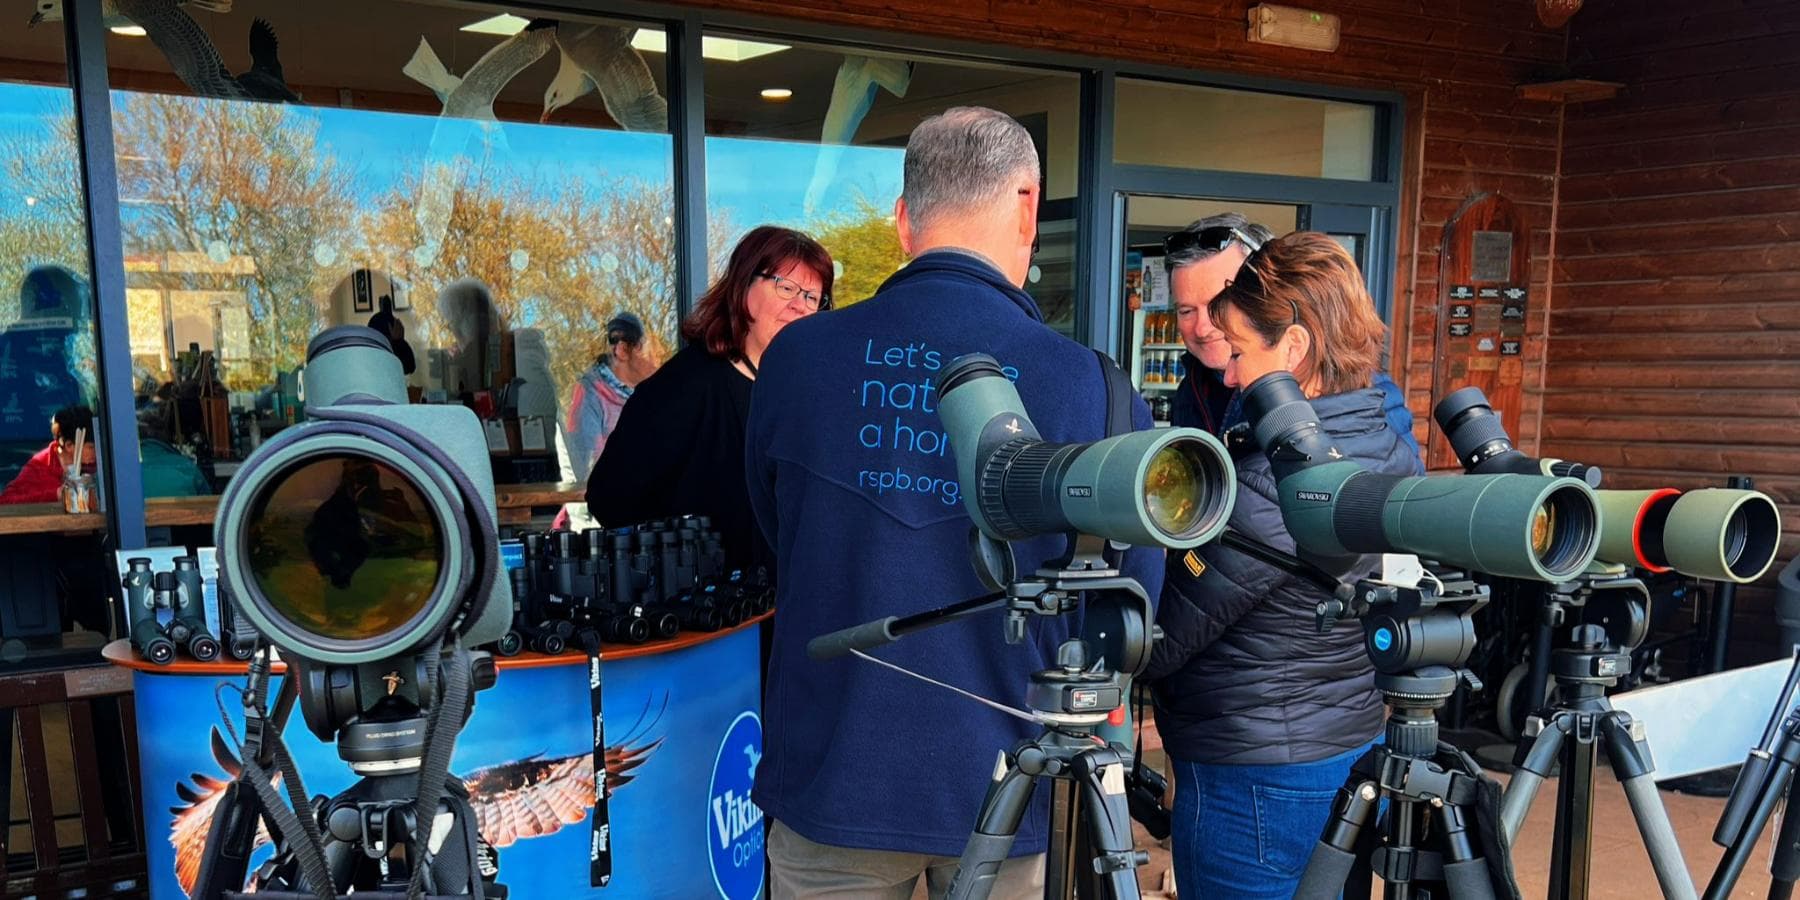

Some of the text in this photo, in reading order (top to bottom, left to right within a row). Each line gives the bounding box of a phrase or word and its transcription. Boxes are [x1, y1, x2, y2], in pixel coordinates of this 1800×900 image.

[866, 339, 941, 370] Let's
[862, 378, 936, 413] nat
[859, 416, 948, 457] a ho
[858, 467, 963, 505] rspb.org.
